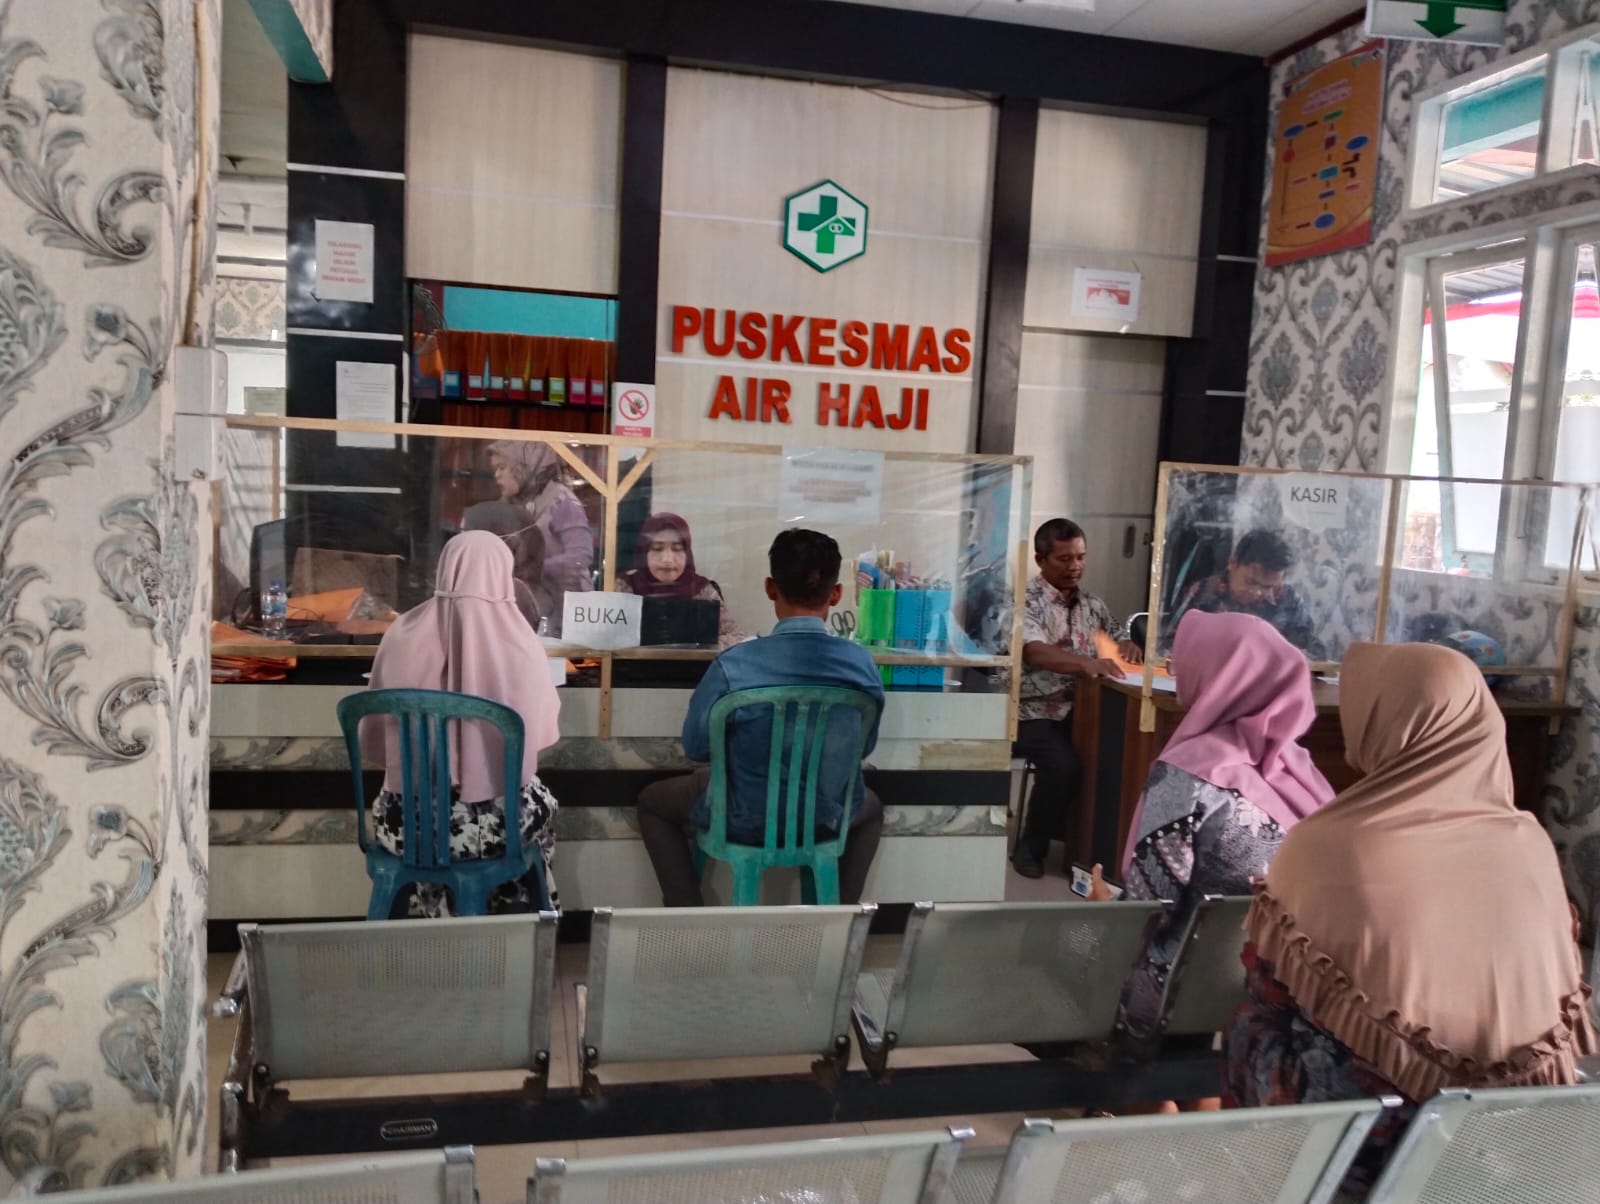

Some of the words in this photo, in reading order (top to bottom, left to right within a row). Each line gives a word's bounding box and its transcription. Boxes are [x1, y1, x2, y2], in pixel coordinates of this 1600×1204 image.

[672, 305, 972, 374] PUSKESMAS
[709, 375, 792, 424] AIR
[817, 382, 930, 431] HAJI
[1290, 487, 1337, 504] KASIR
[574, 606, 627, 625] BUKA
